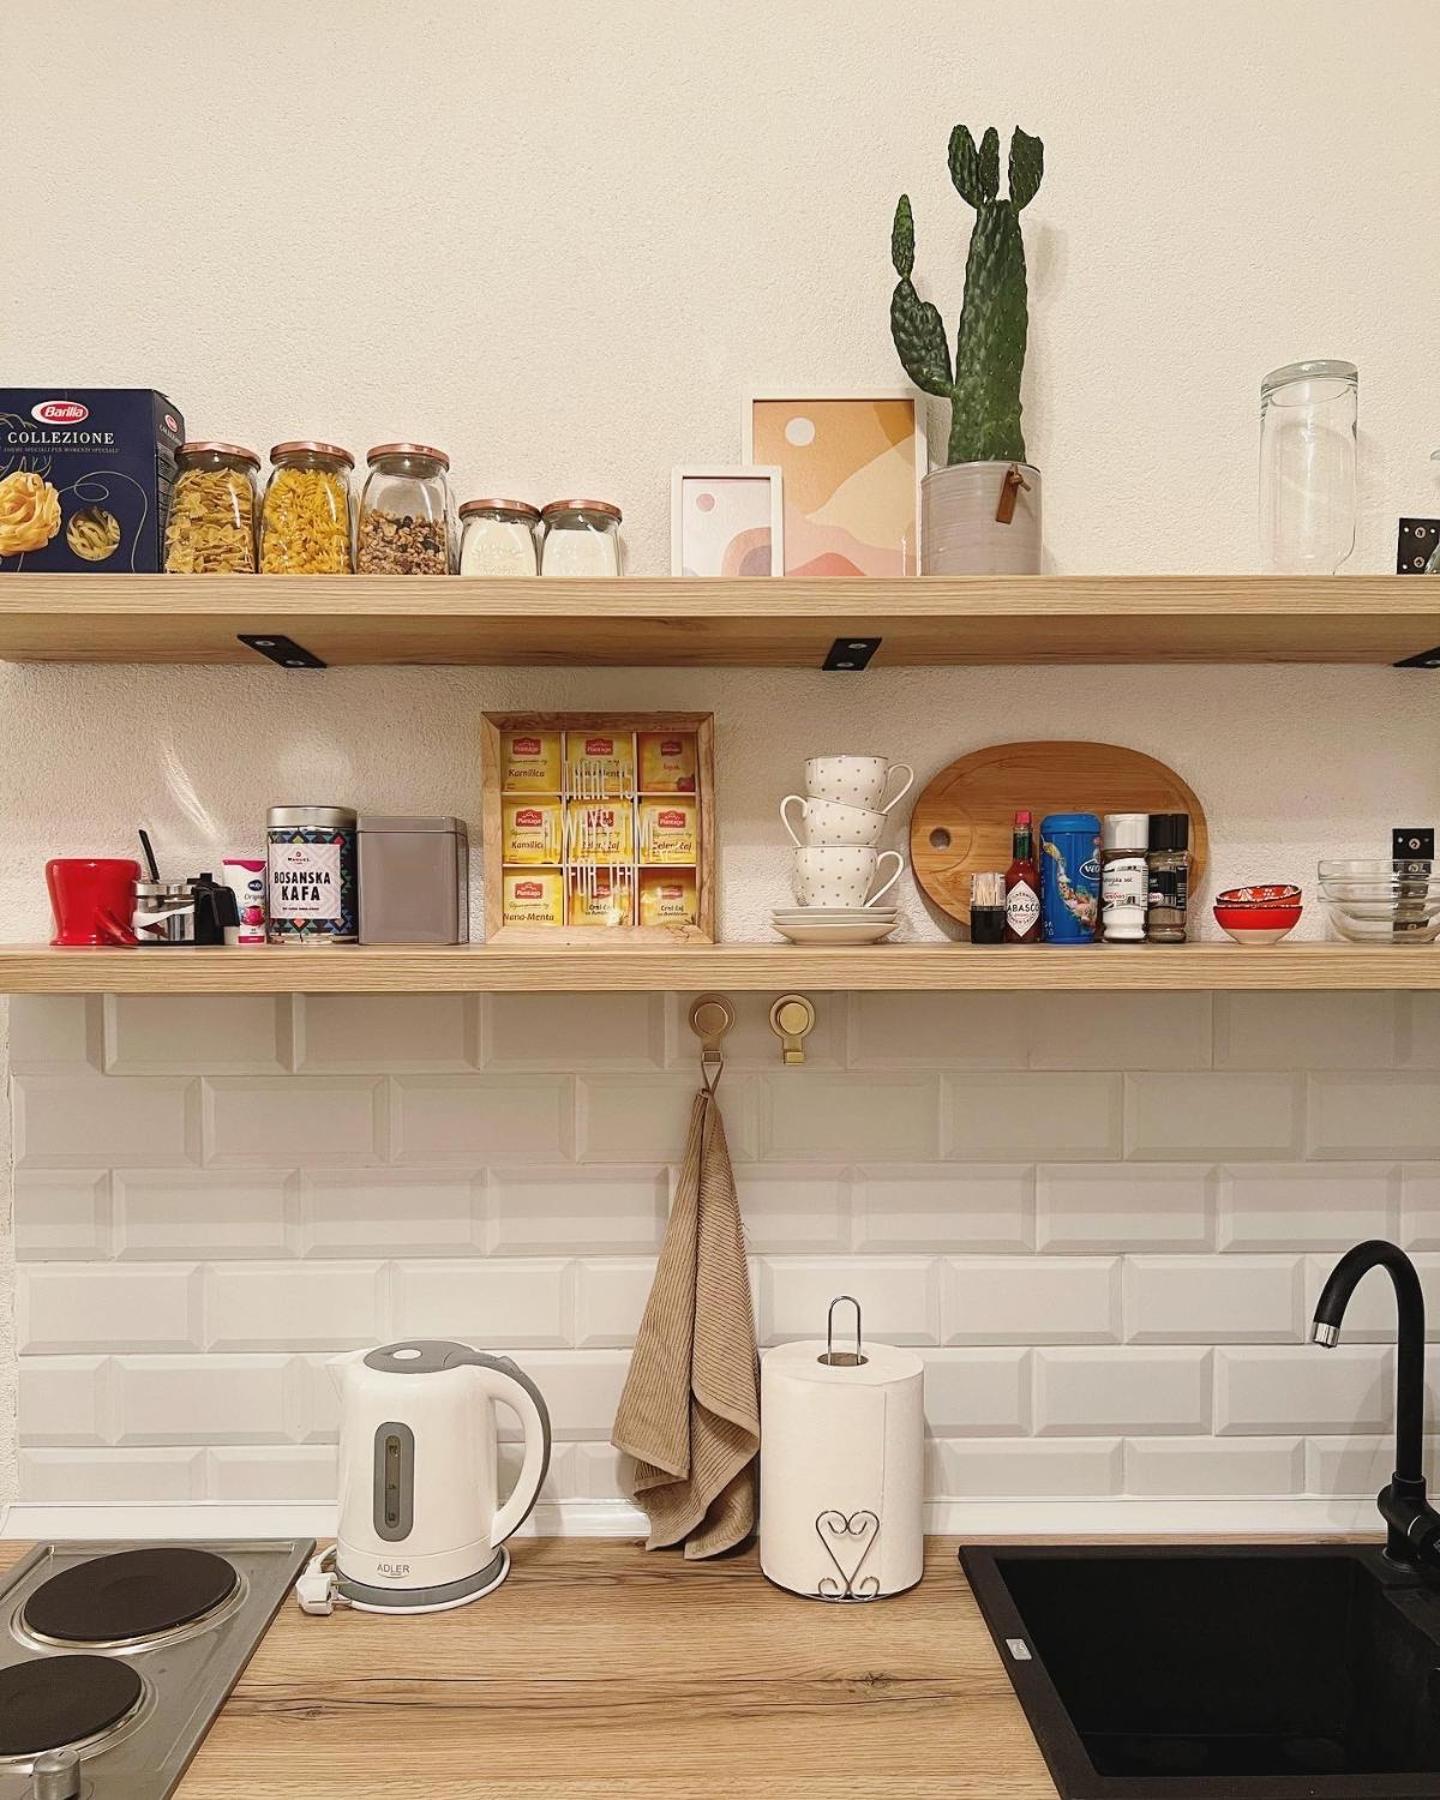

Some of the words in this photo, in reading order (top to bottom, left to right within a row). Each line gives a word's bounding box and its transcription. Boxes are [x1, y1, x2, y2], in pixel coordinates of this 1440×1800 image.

[44, 406, 84, 418] Barilla
[7, 431, 115, 445] COLLEZIONE
[274, 871, 331, 884] BOSANSKA
[281, 886, 320, 901] KAFA
[1007, 903, 1040, 912] ABASCO
[377, 1563, 410, 1573] ADLER
